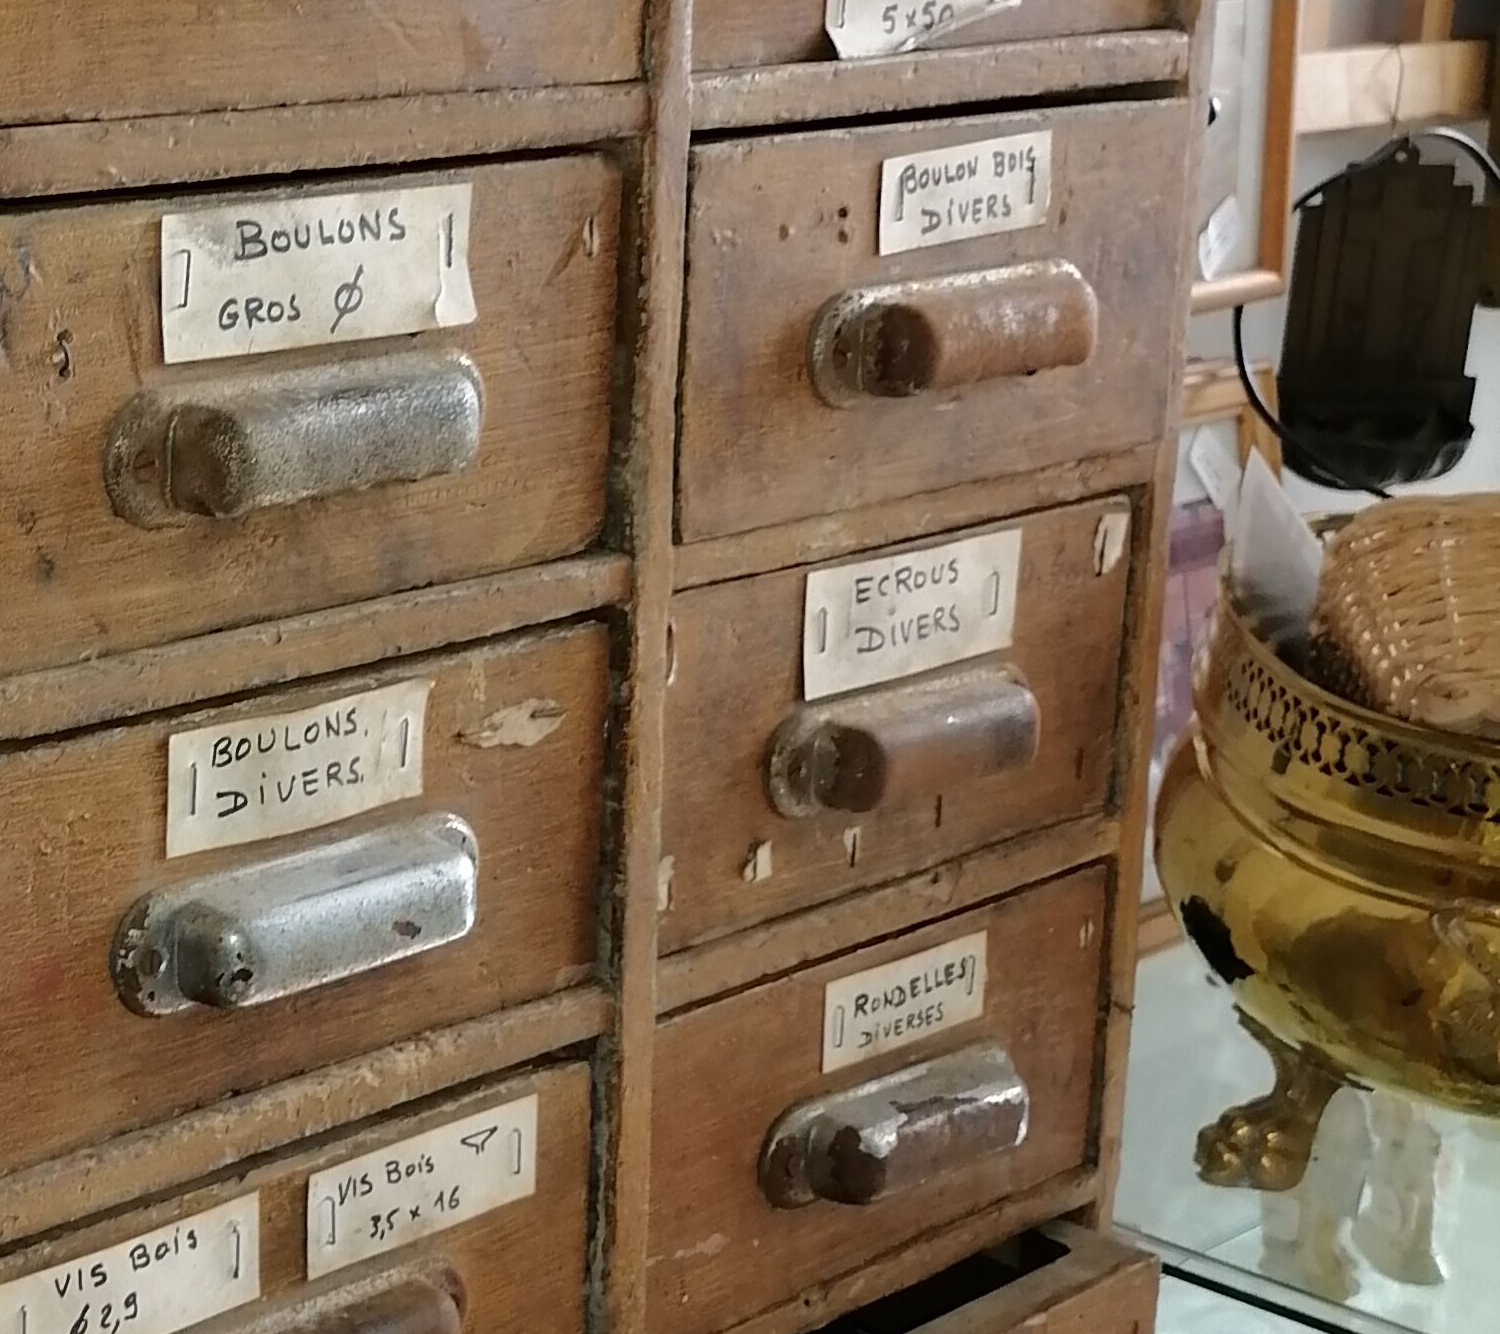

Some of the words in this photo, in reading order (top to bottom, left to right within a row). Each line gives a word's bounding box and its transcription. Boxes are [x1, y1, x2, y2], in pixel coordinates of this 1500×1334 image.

[901, 155, 980, 195] BOULON
[992, 145, 1037, 179] BOIS
[234, 208, 407, 261] BOULONS
[218, 294, 301, 331] GROS
[855, 557, 959, 604] ECROUS
[853, 956, 968, 1018] RONDELLES
[338, 1173, 374, 1207] VIS
[54, 1262, 108, 1299] VIS
